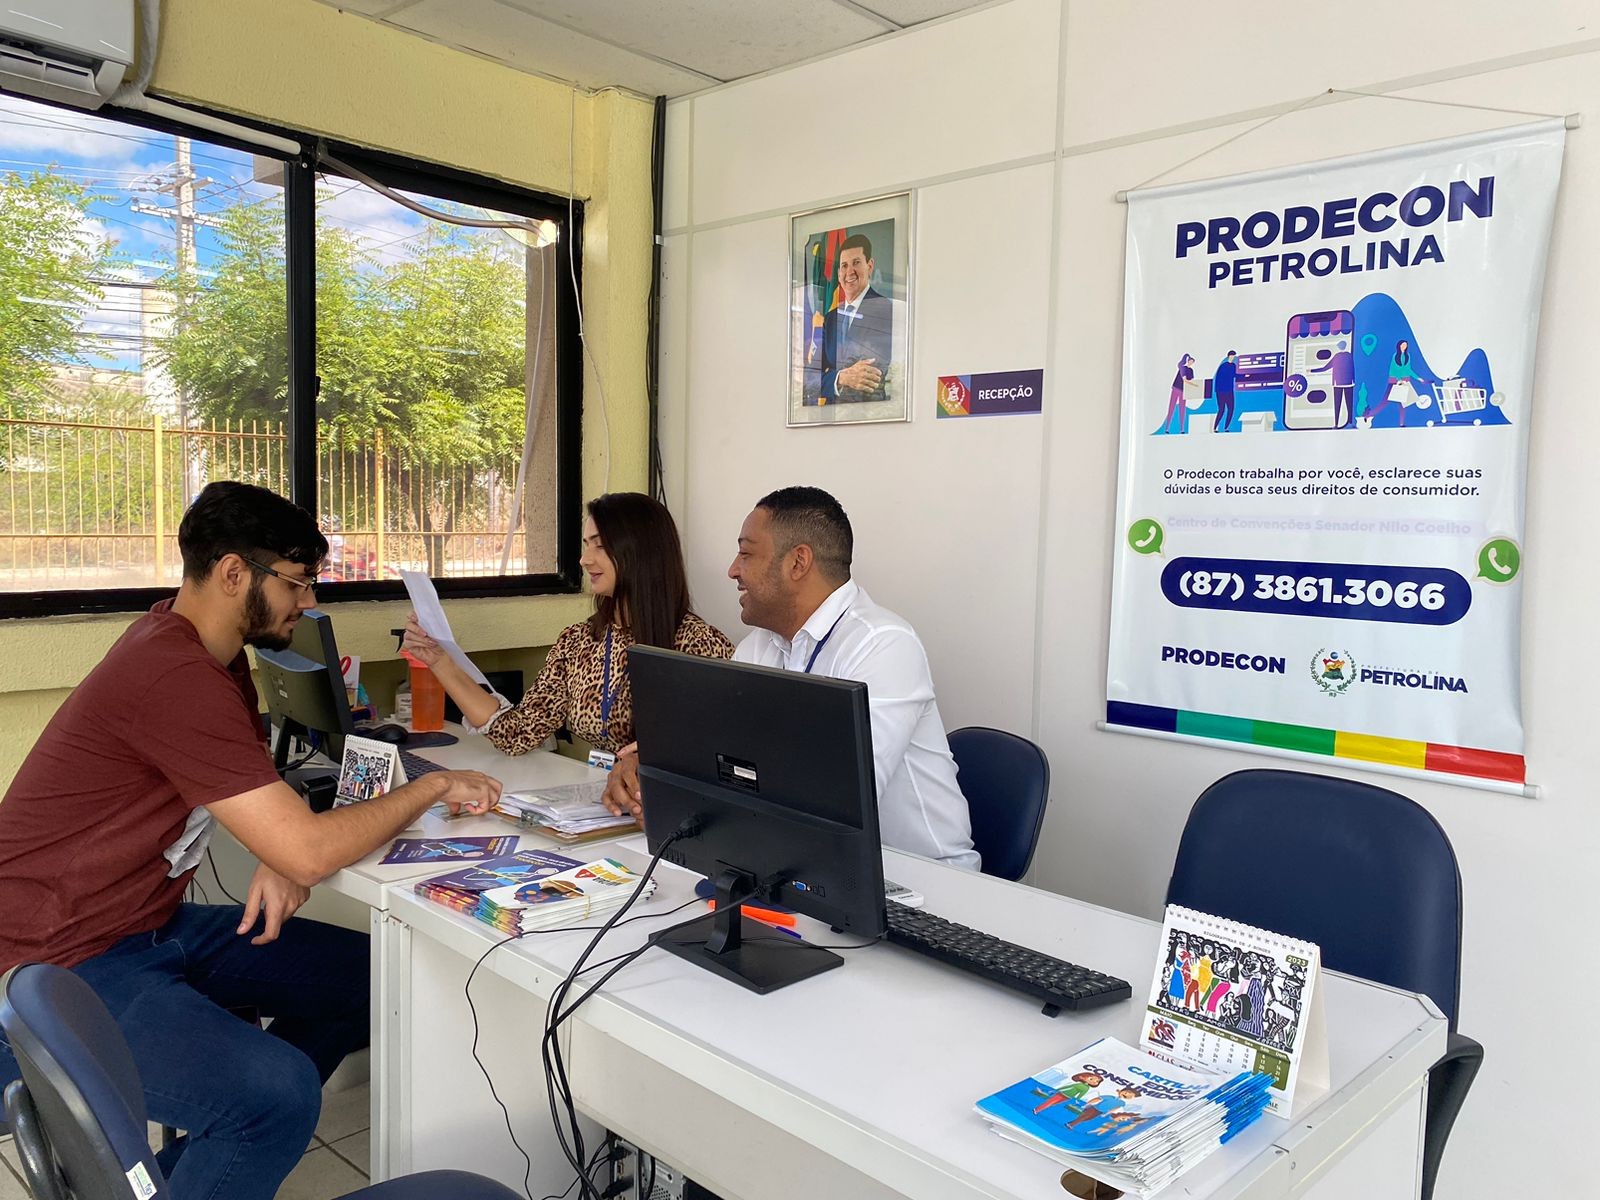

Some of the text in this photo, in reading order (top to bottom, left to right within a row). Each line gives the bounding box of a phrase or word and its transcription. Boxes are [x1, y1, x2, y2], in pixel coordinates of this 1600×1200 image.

[1175, 176, 1495, 258] PRODECON
[1208, 234, 1445, 288] PETROLINA
[978, 385, 1033, 401] RECEPÇÃO
[1288, 379, 1303, 392] %
[1163, 466, 1482, 481] O Prodecon trabalha por você, esclarece suas
[1164, 483, 1480, 496] dúvidas e busca seus direitos de consumidor.
[1167, 517, 1472, 535] Centro de Convenções Senador Nilo Coelho
[1179, 570, 1446, 611] (87) 3861.3066
[1161, 646, 1286, 674] PRODECON
[1360, 668, 1469, 694] PETROLINA
[1288, 956, 1306, 967] 2023
[1160, 1010, 1172, 1018] MAIO
